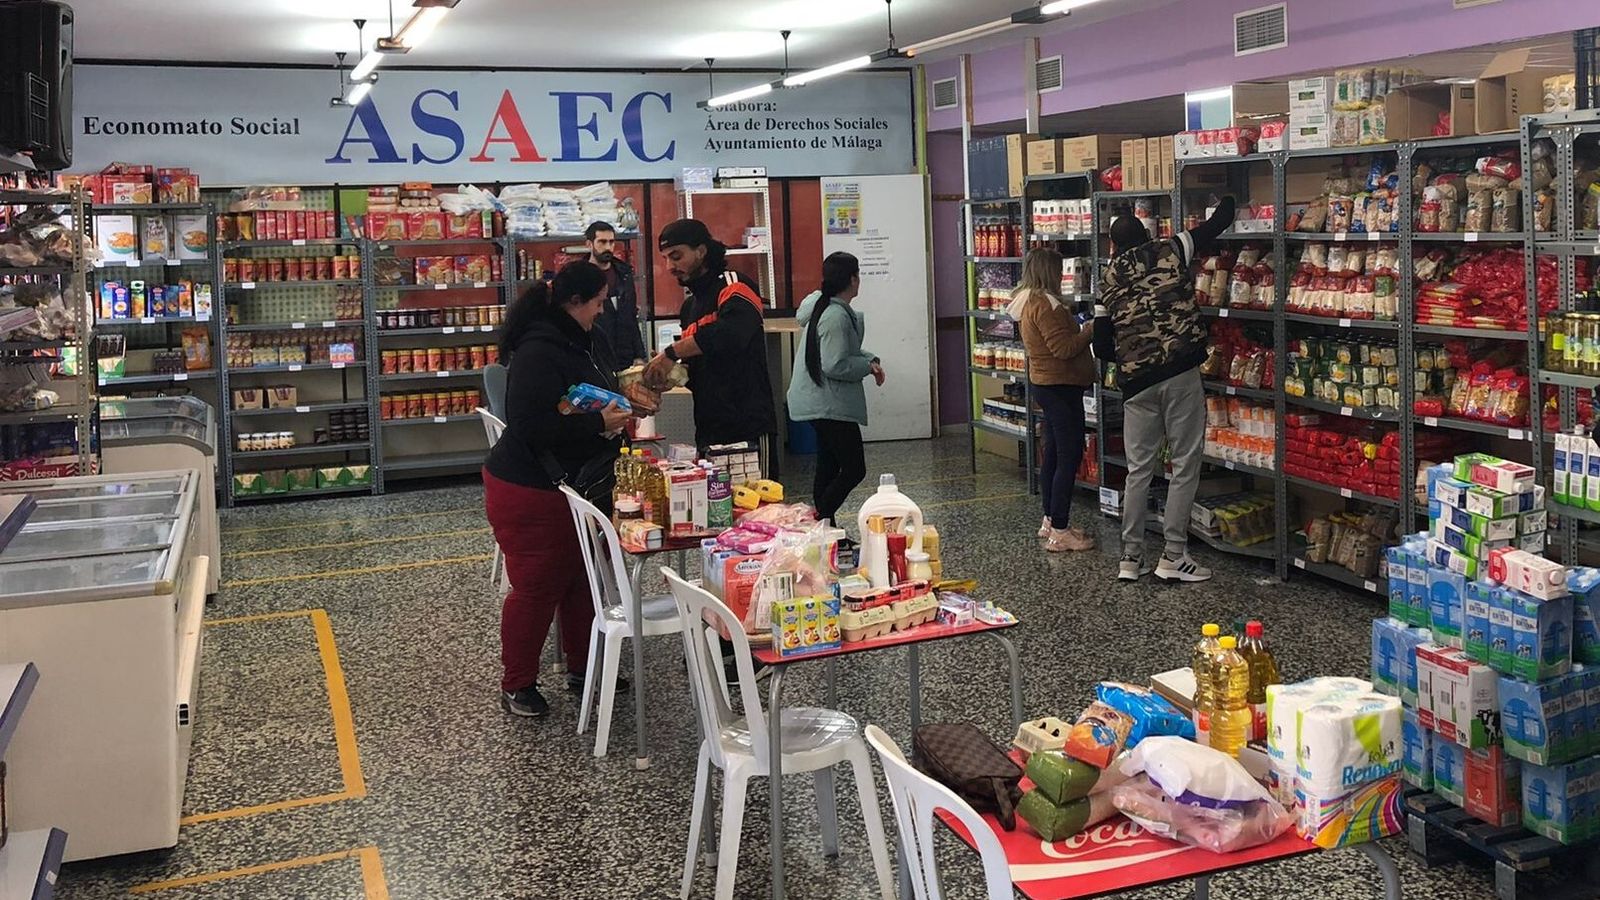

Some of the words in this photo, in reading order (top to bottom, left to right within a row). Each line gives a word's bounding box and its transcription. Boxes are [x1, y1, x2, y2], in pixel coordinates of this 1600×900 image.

[703, 99, 777, 112] olabora:
[83, 116, 223, 135] Economato
[230, 117, 301, 135] Social
[325, 88, 676, 165] ASAEC
[704, 115, 740, 131] Área
[744, 118, 761, 131] de
[765, 117, 830, 131] Derechos
[833, 117, 889, 130] Sociales
[704, 137, 806, 153] Ayuntamiento
[810, 136, 827, 149] de
[831, 136, 882, 152] Málaga
[15, 467, 60, 481] Dulcesol
[710, 481, 725, 492] Sin
